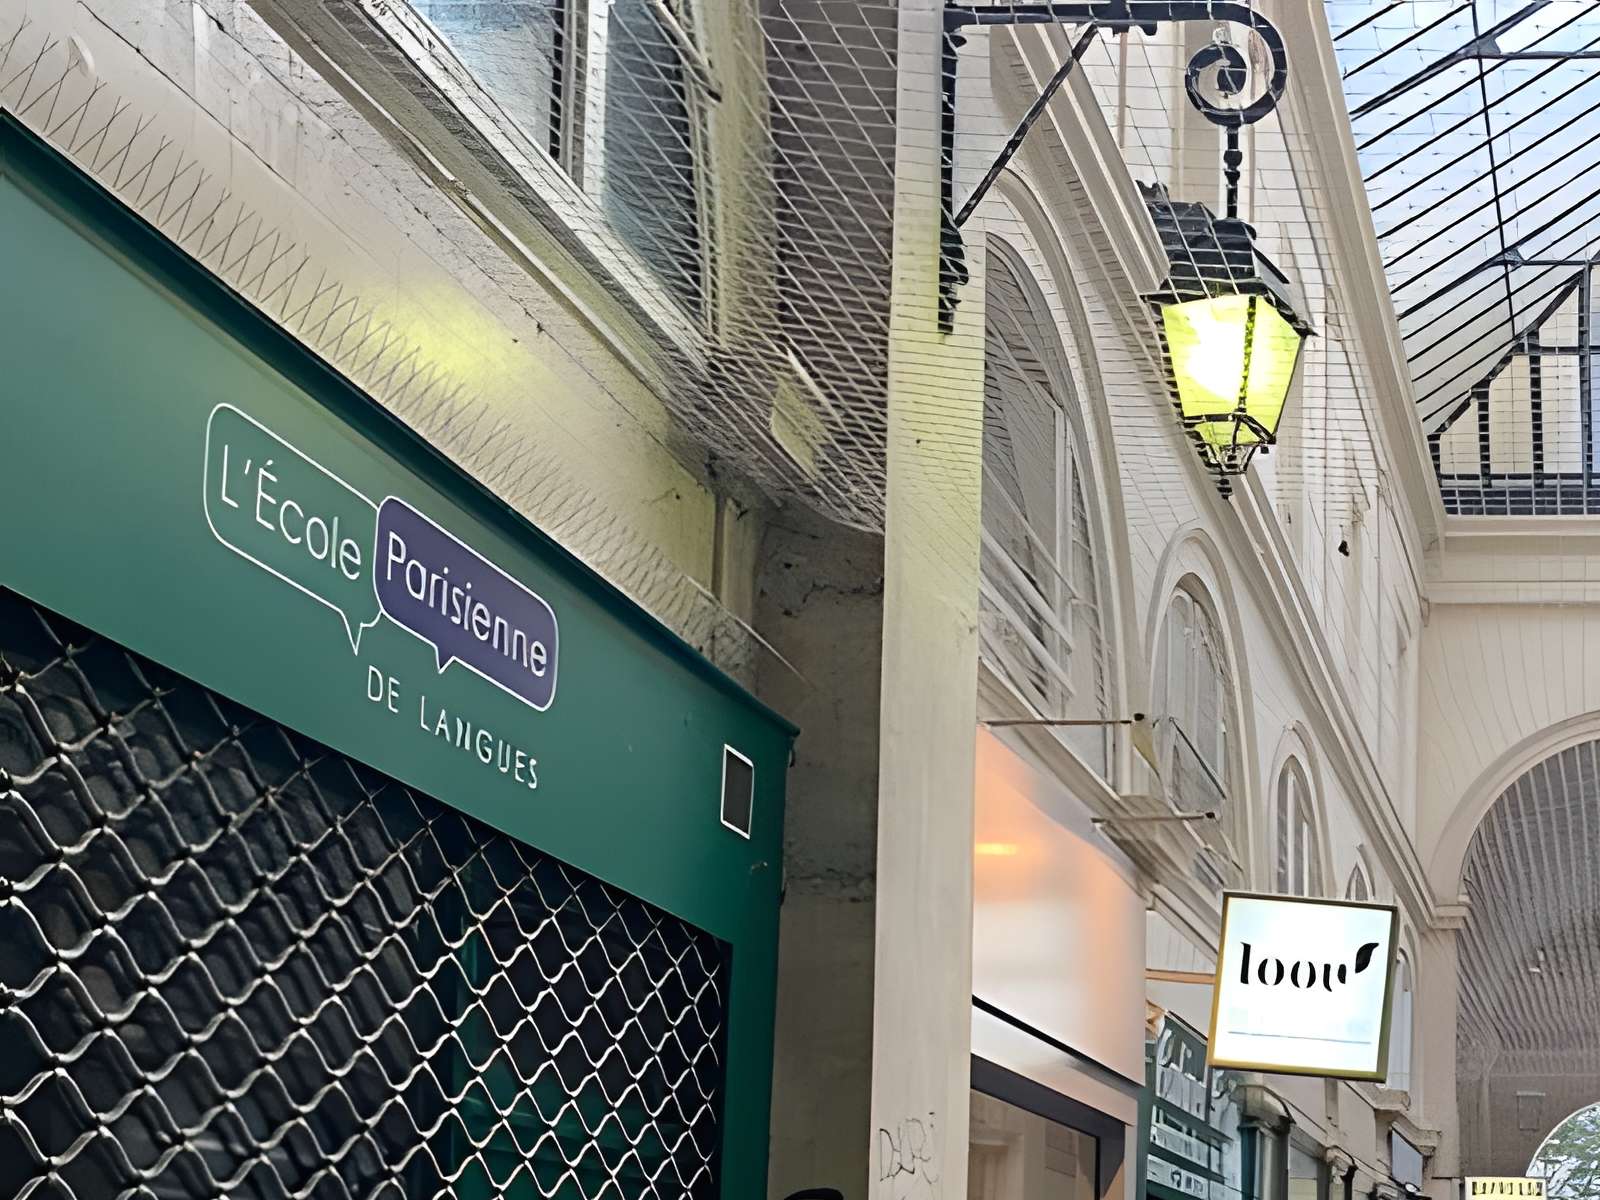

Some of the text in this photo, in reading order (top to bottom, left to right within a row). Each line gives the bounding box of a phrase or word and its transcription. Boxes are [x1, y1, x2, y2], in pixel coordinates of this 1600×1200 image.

[221, 444, 547, 677] L'École Parisienne
[368, 665, 538, 790] DE LANGUES
